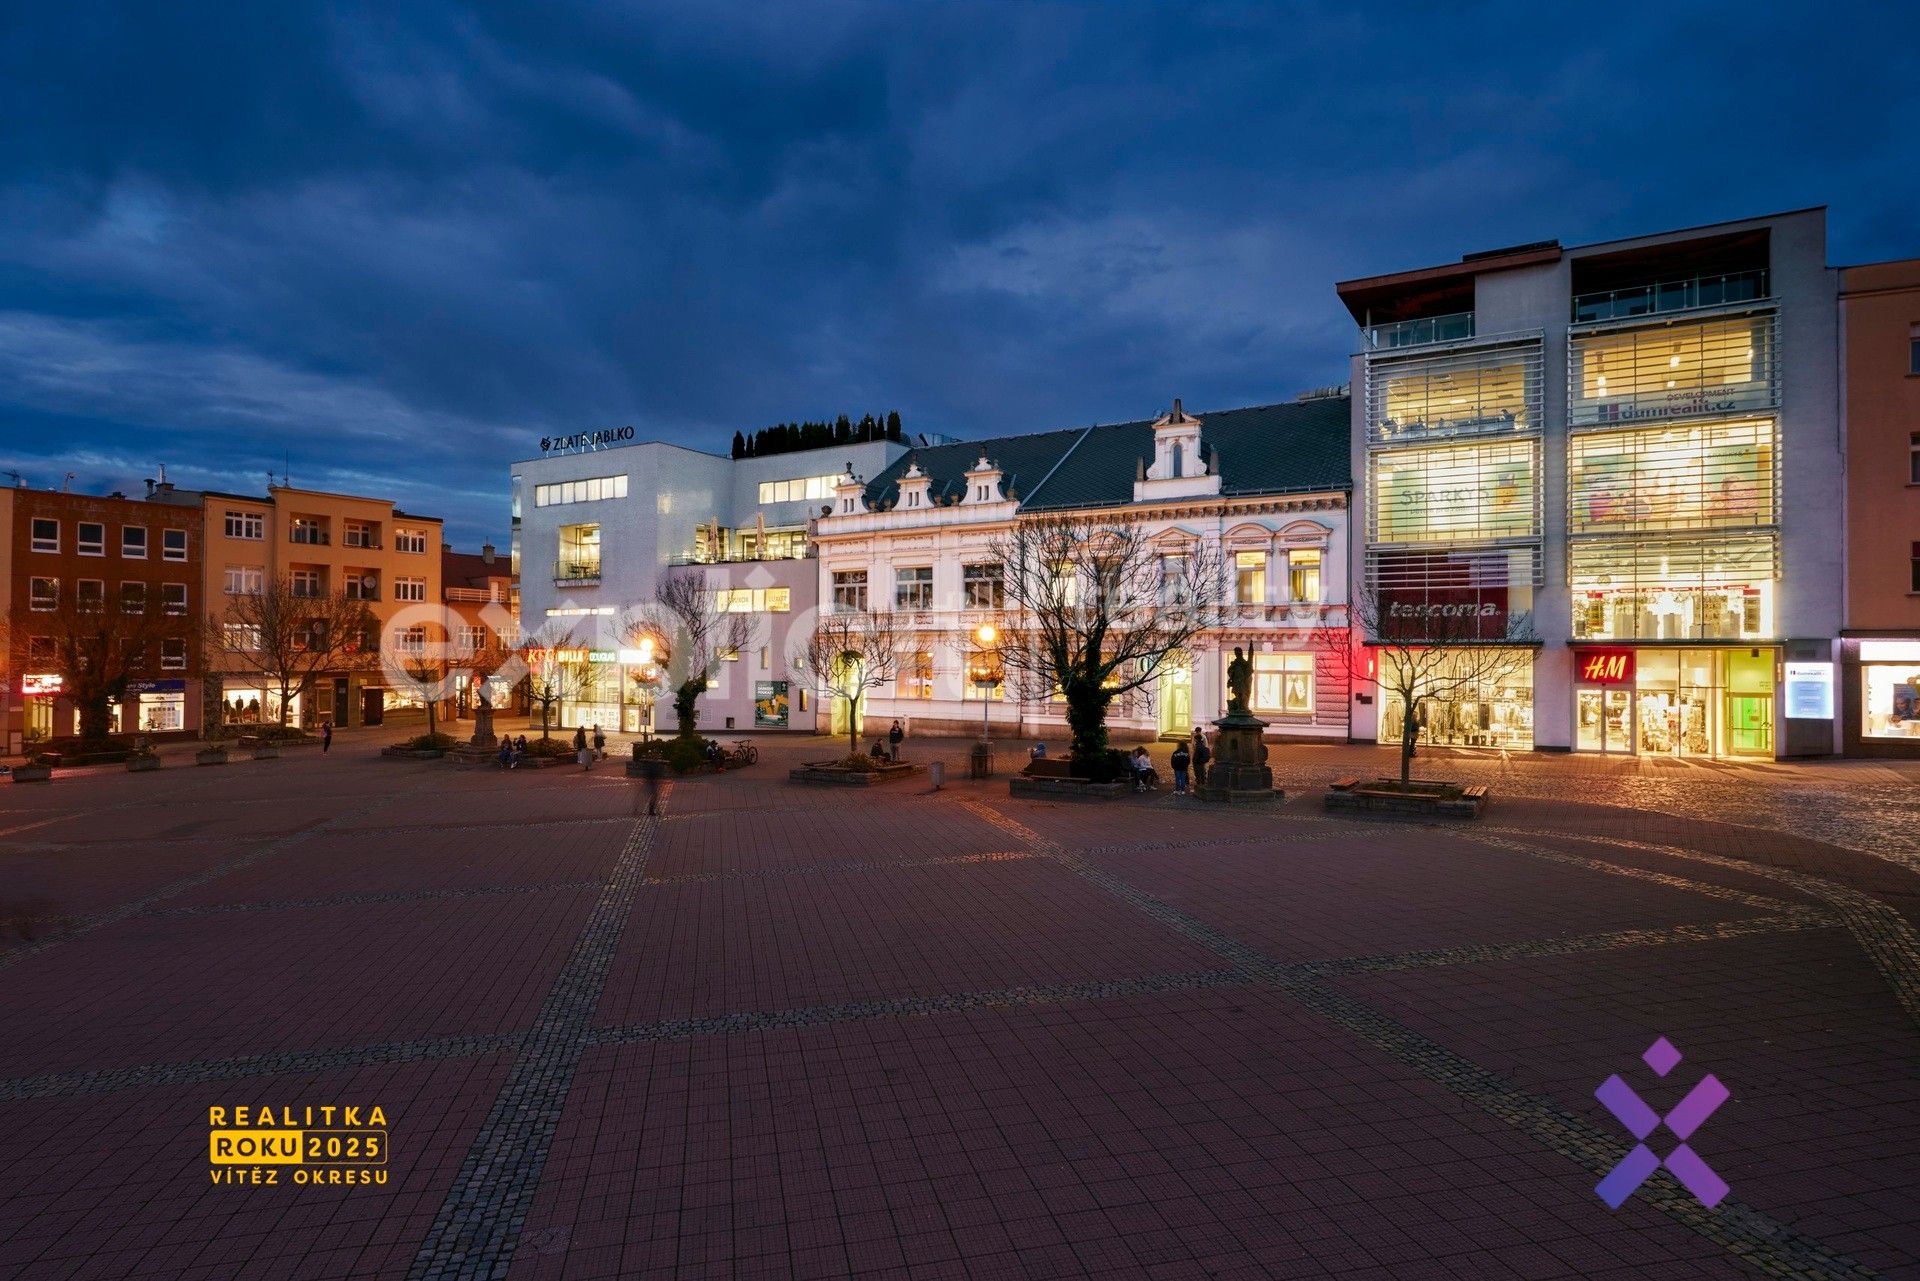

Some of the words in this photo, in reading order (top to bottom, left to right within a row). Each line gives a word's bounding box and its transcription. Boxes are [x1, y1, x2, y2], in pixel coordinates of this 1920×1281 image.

[1666, 387, 1735, 401] DEVELOPMENT
[553, 431, 588, 451] ZLATÉ
[591, 425, 635, 446] JABLKO
[1584, 655, 1627, 680] H&M
